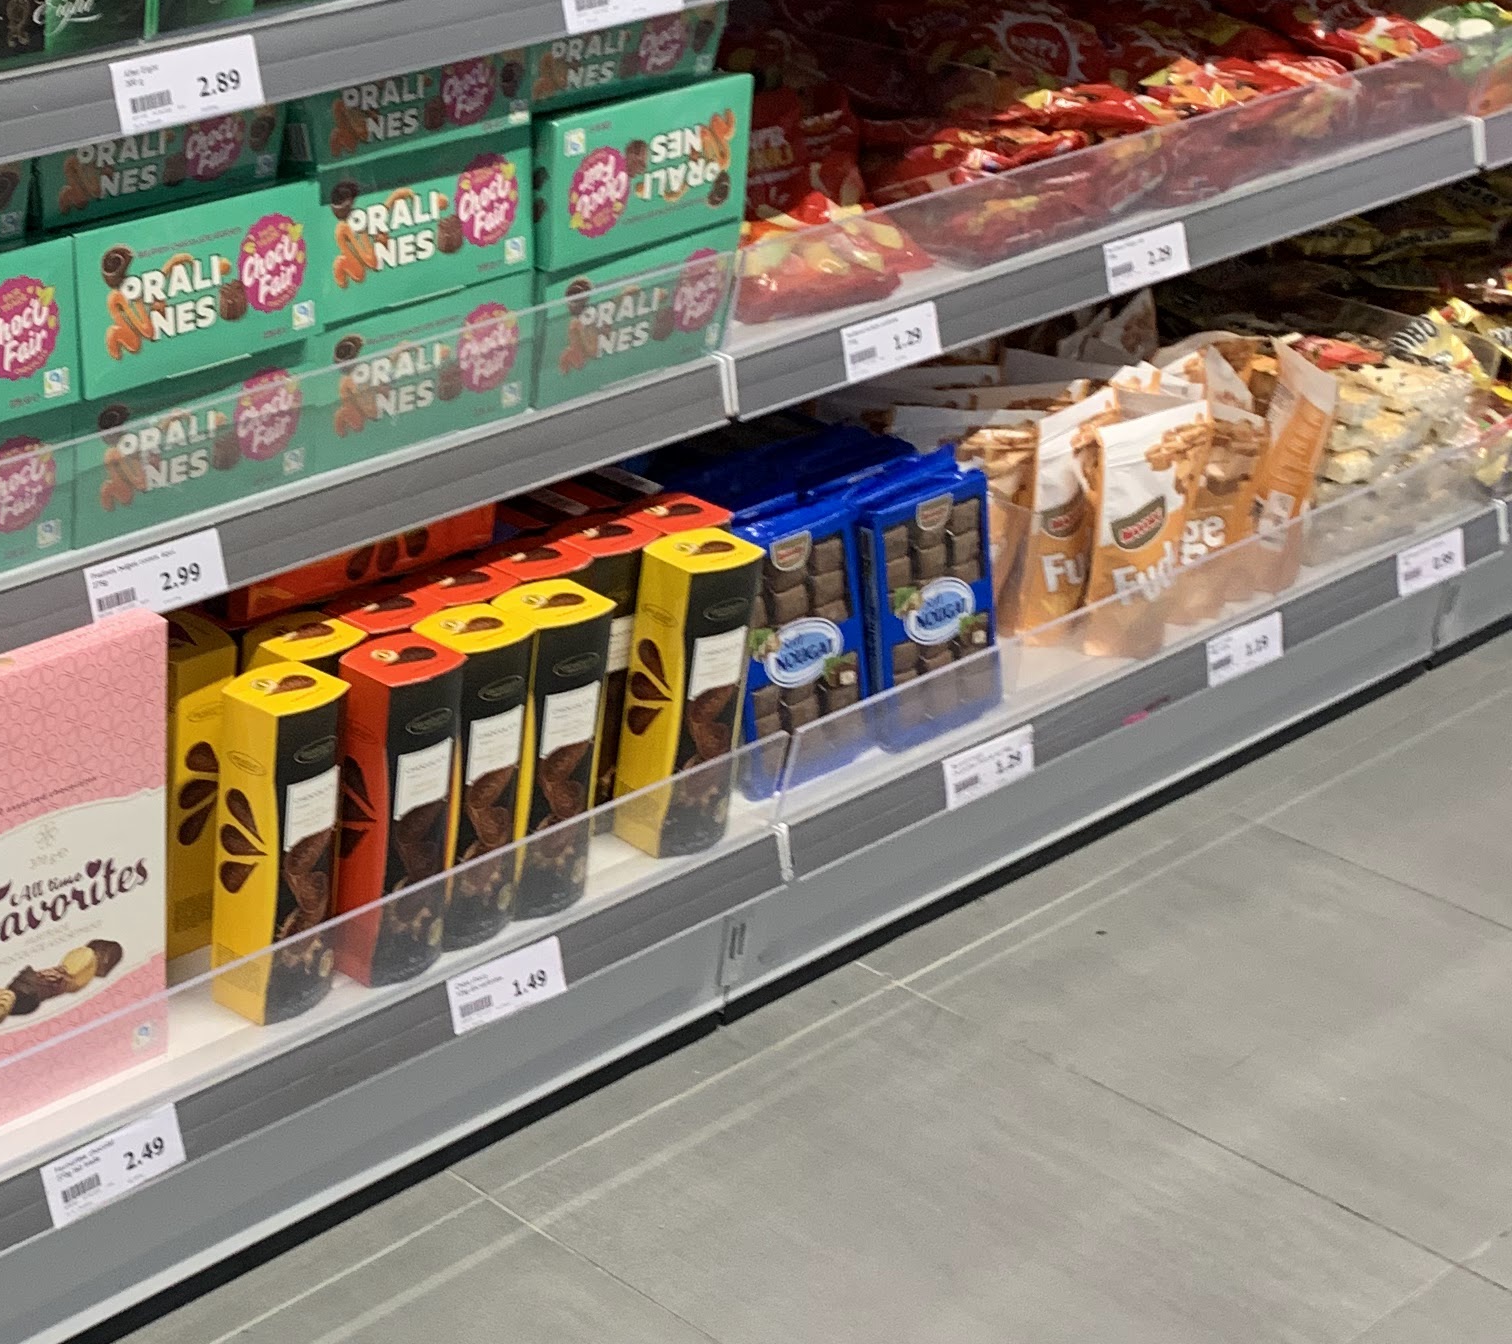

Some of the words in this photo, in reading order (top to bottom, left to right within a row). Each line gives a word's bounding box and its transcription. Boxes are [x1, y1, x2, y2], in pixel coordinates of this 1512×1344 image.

[197, 68, 240, 97] 2.89
[374, 229, 435, 270] NES
[150, 296, 217, 339] NES
[2, 328, 48, 373] Fair
[376, 380, 435, 418] NES
[144, 449, 210, 490] NES
[159, 561, 201, 592] 2.99
[513, 969, 545, 997] 1.49
[122, 1136, 164, 1170] 2.49
